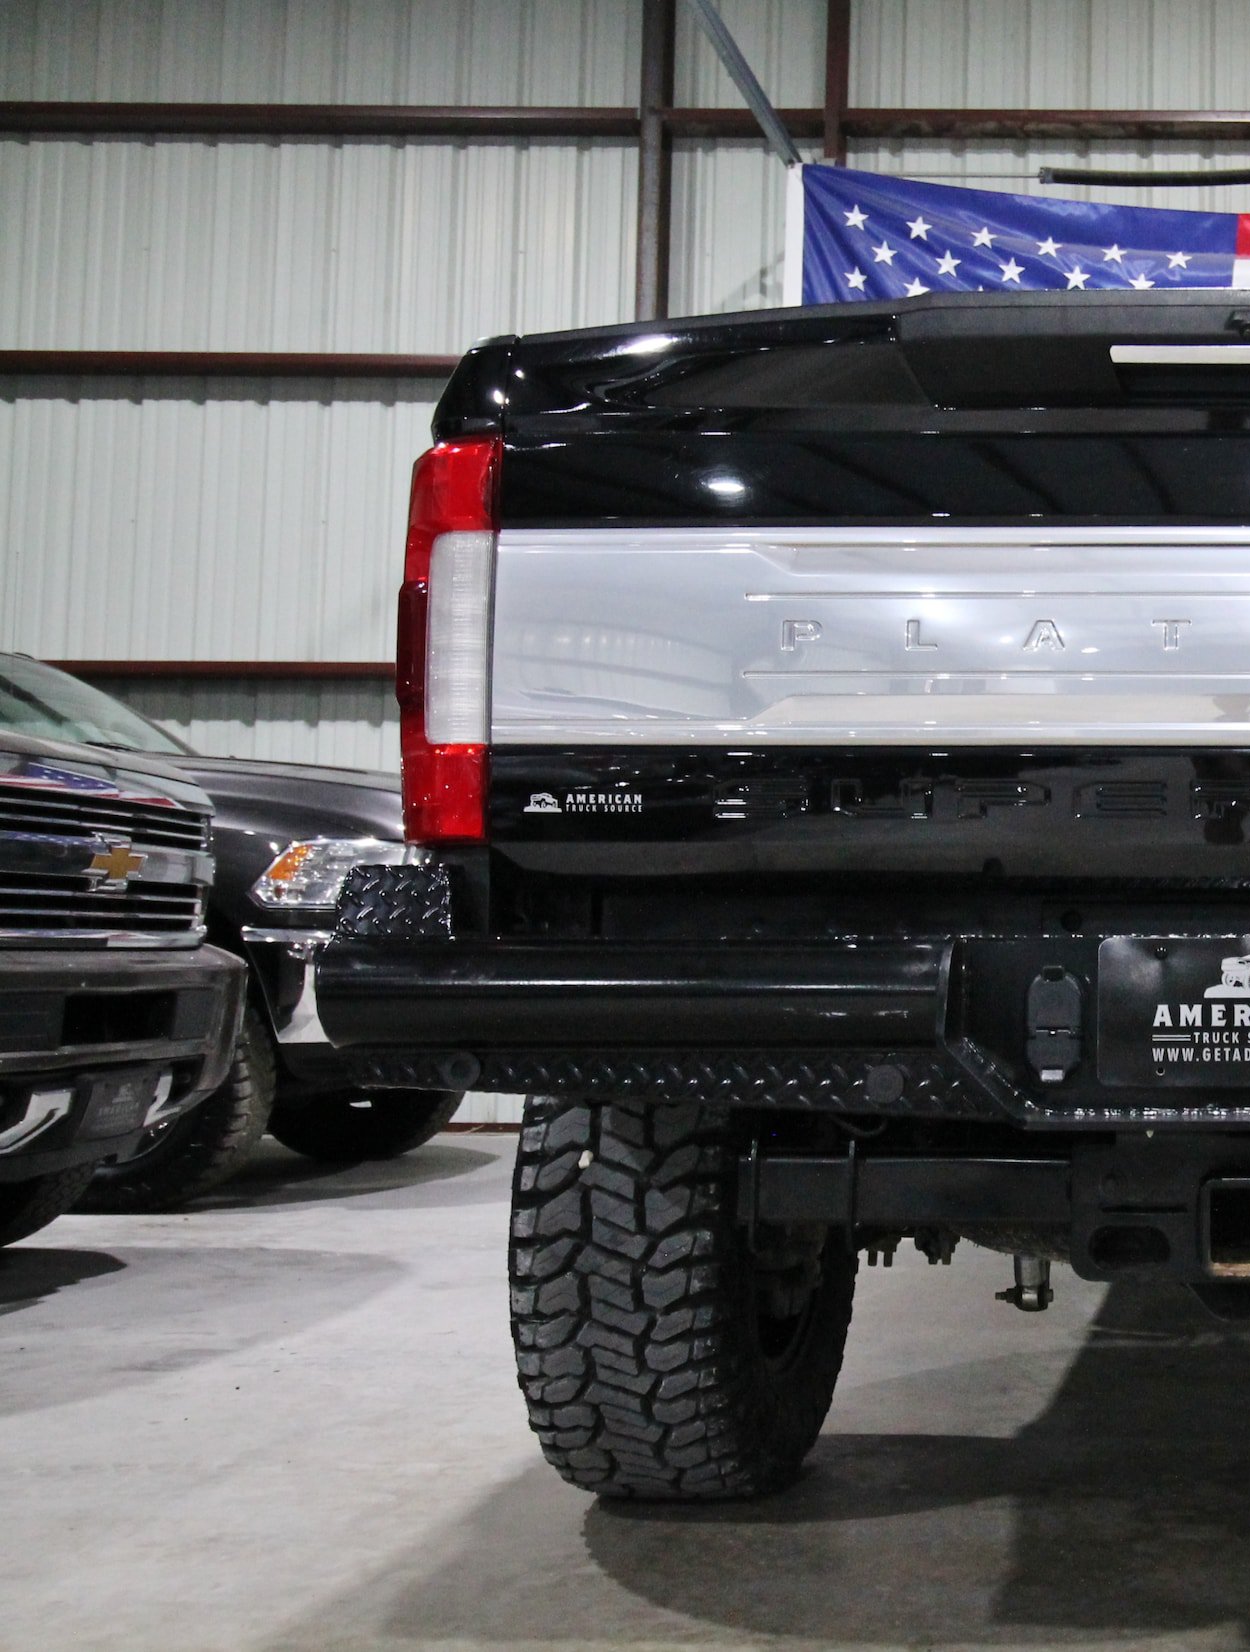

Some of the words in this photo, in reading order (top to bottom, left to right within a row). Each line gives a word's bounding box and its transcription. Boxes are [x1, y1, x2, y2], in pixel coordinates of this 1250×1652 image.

[565, 793, 643, 804] AMERICAN
[565, 804, 598, 813] TRUCK
[604, 804, 643, 813] SOURCE
[1193, 1031, 1240, 1044] TRUCK
